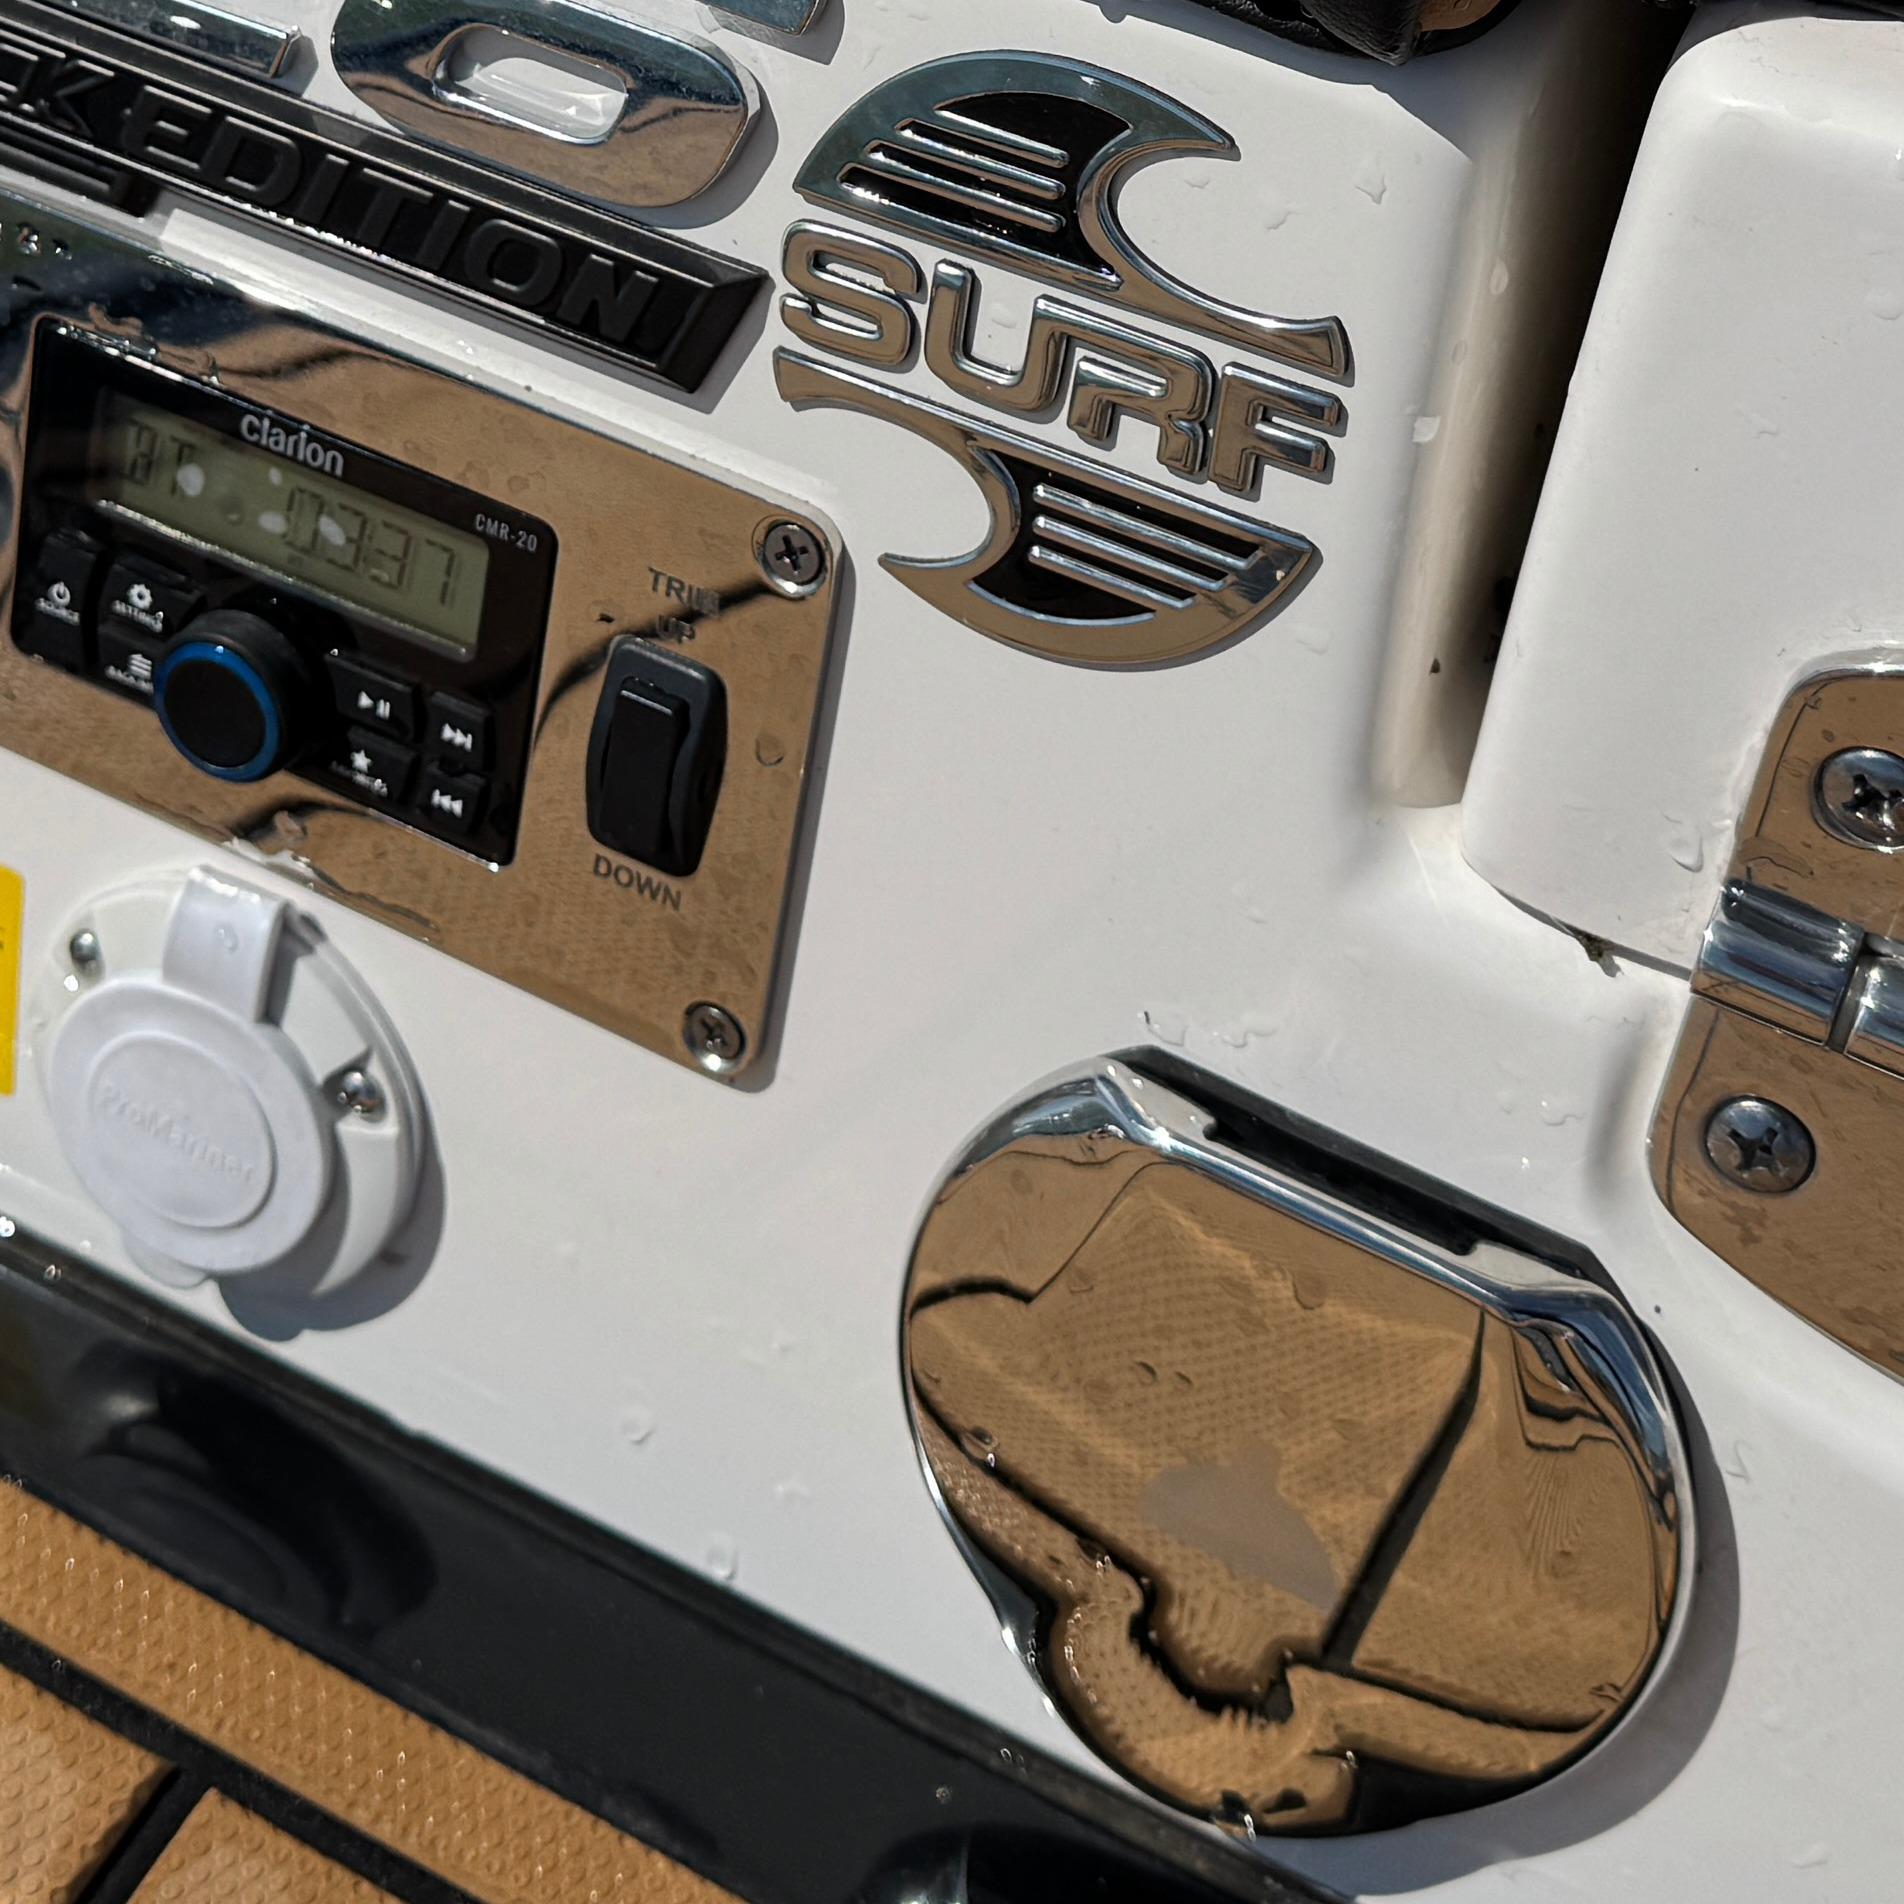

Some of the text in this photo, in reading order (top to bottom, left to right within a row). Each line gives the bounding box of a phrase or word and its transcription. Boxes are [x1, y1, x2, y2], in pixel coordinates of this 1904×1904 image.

[122, 84, 659, 342] EDITION
[780, 218, 1341, 492] SURF
[240, 412, 345, 477] clarion
[474, 512, 538, 553] CMR-20
[593, 854, 682, 911] DOWN
